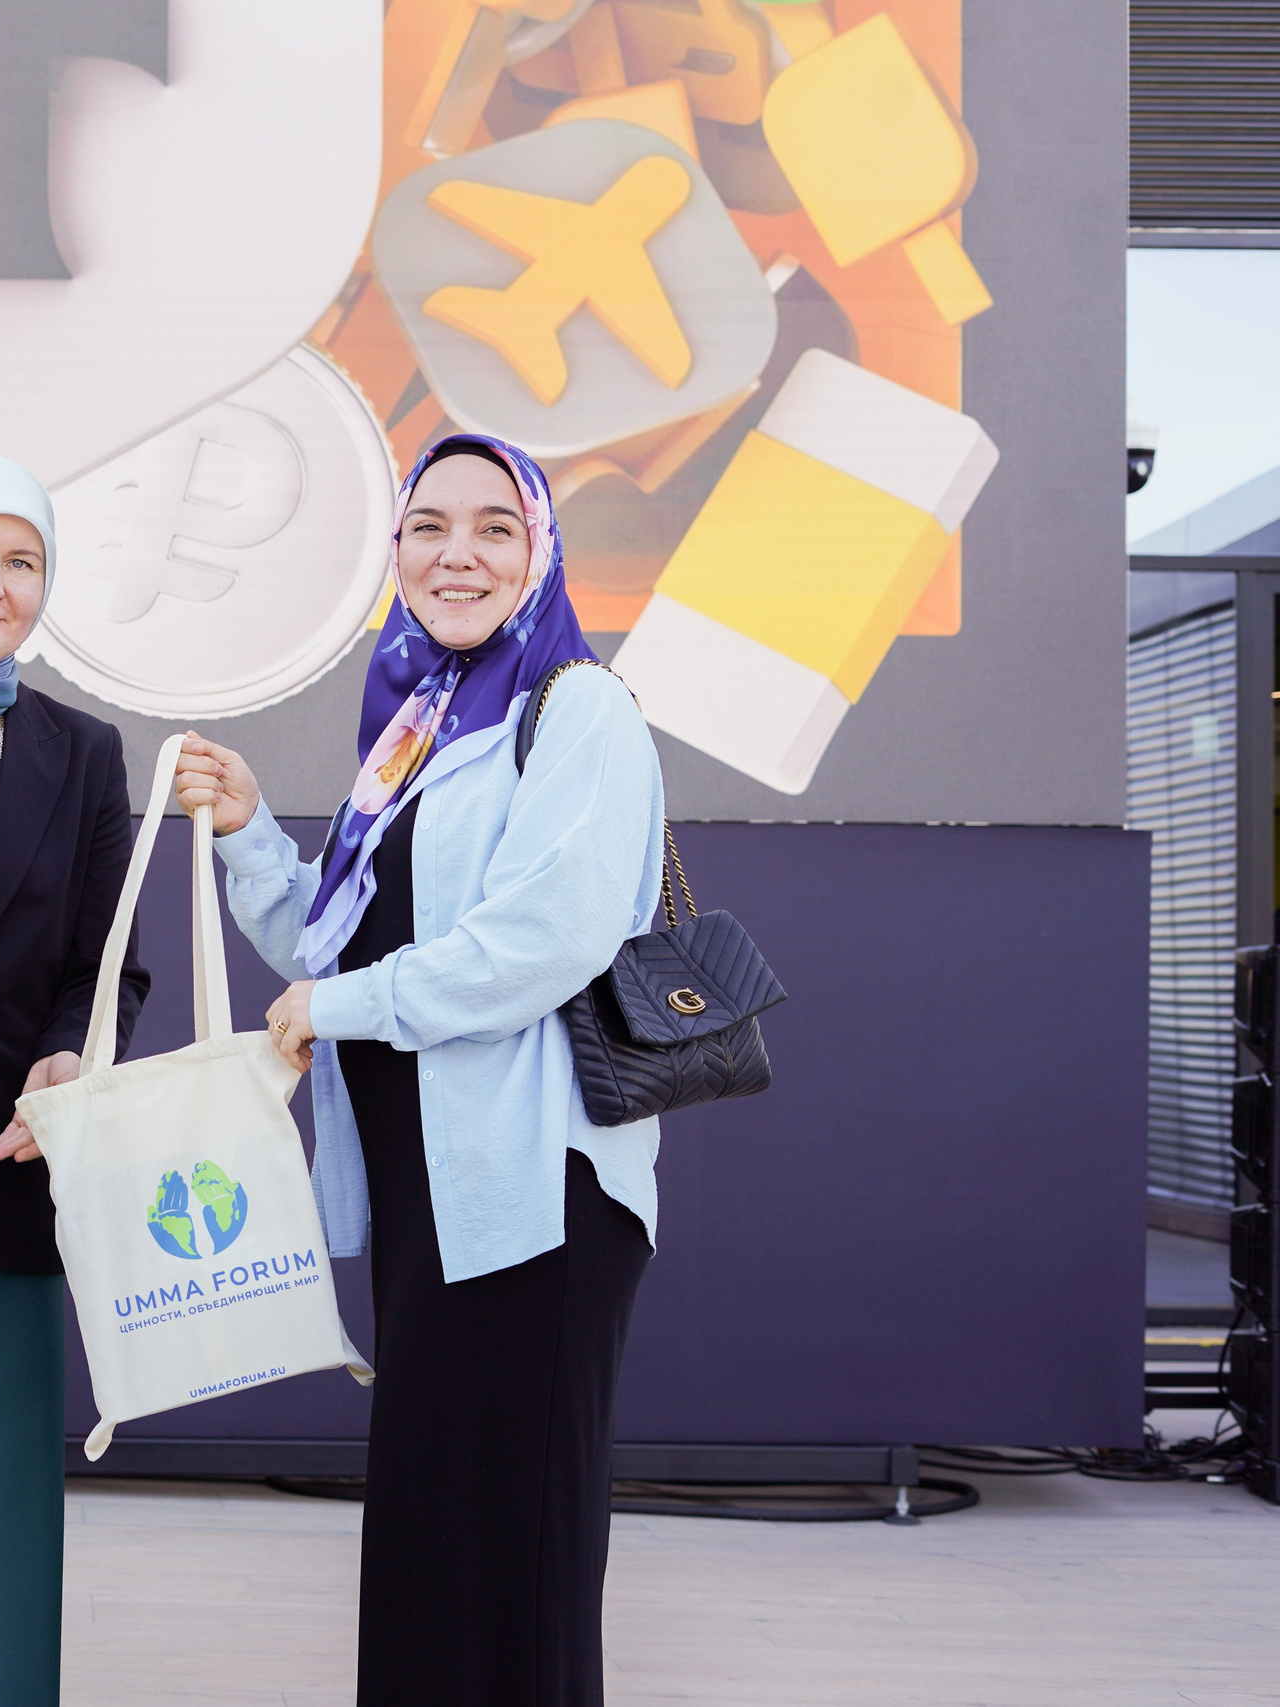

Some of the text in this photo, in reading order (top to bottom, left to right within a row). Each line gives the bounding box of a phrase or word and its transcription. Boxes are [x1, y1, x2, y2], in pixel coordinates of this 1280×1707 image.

[115, 1249, 317, 1317] UMMA FORUM
[120, 1274, 320, 1334] ЦЕННОСТИ, ОБЪЕДИНЯЮЩИЕ МИР
[190, 1366, 286, 1398] UMMAFORUM.RU
